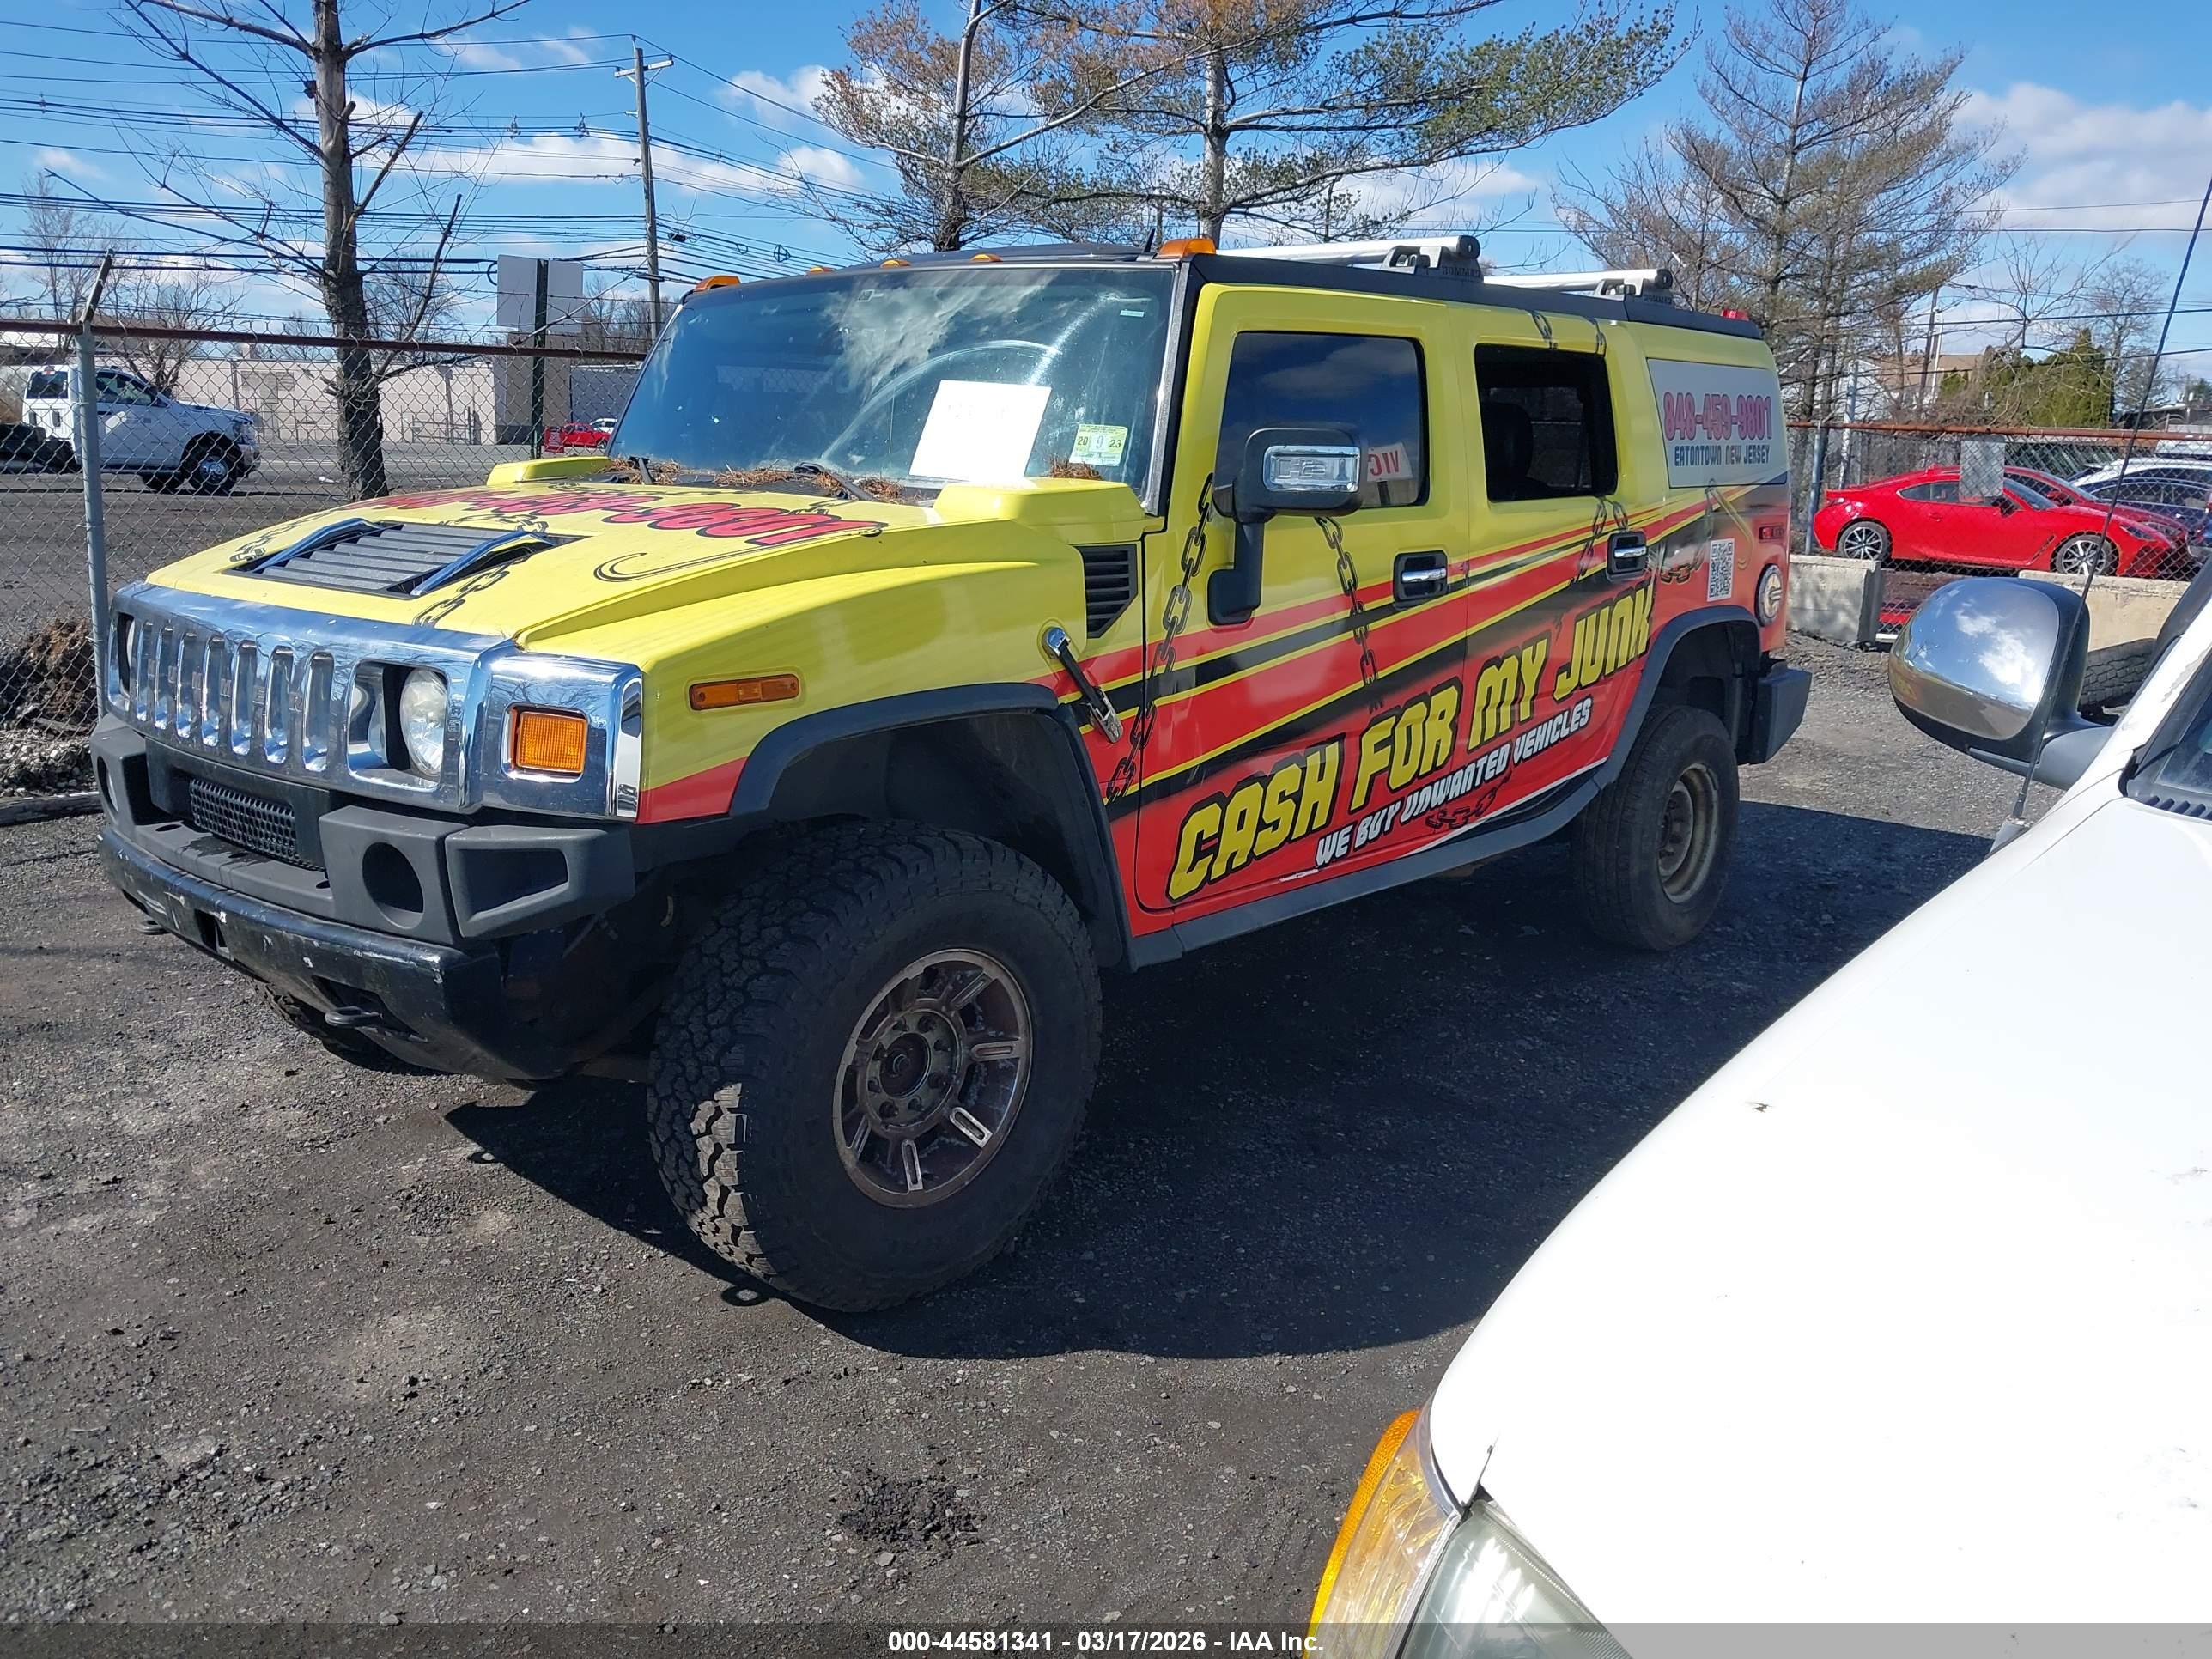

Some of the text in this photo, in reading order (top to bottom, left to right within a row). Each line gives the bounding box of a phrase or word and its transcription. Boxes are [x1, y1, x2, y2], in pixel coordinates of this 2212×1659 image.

[1663, 391, 1772, 441] 848-459-9801
[1077, 435, 1089, 446] 20
[1109, 439, 1122, 448] 23
[1725, 445, 1742, 465] NEW
[1743, 444, 1771, 464] JERSEY
[1167, 586, 1655, 902] CASH FOR MY JUNK
[1315, 697, 1594, 868] WE BUY UNWANTED VEHICLES
